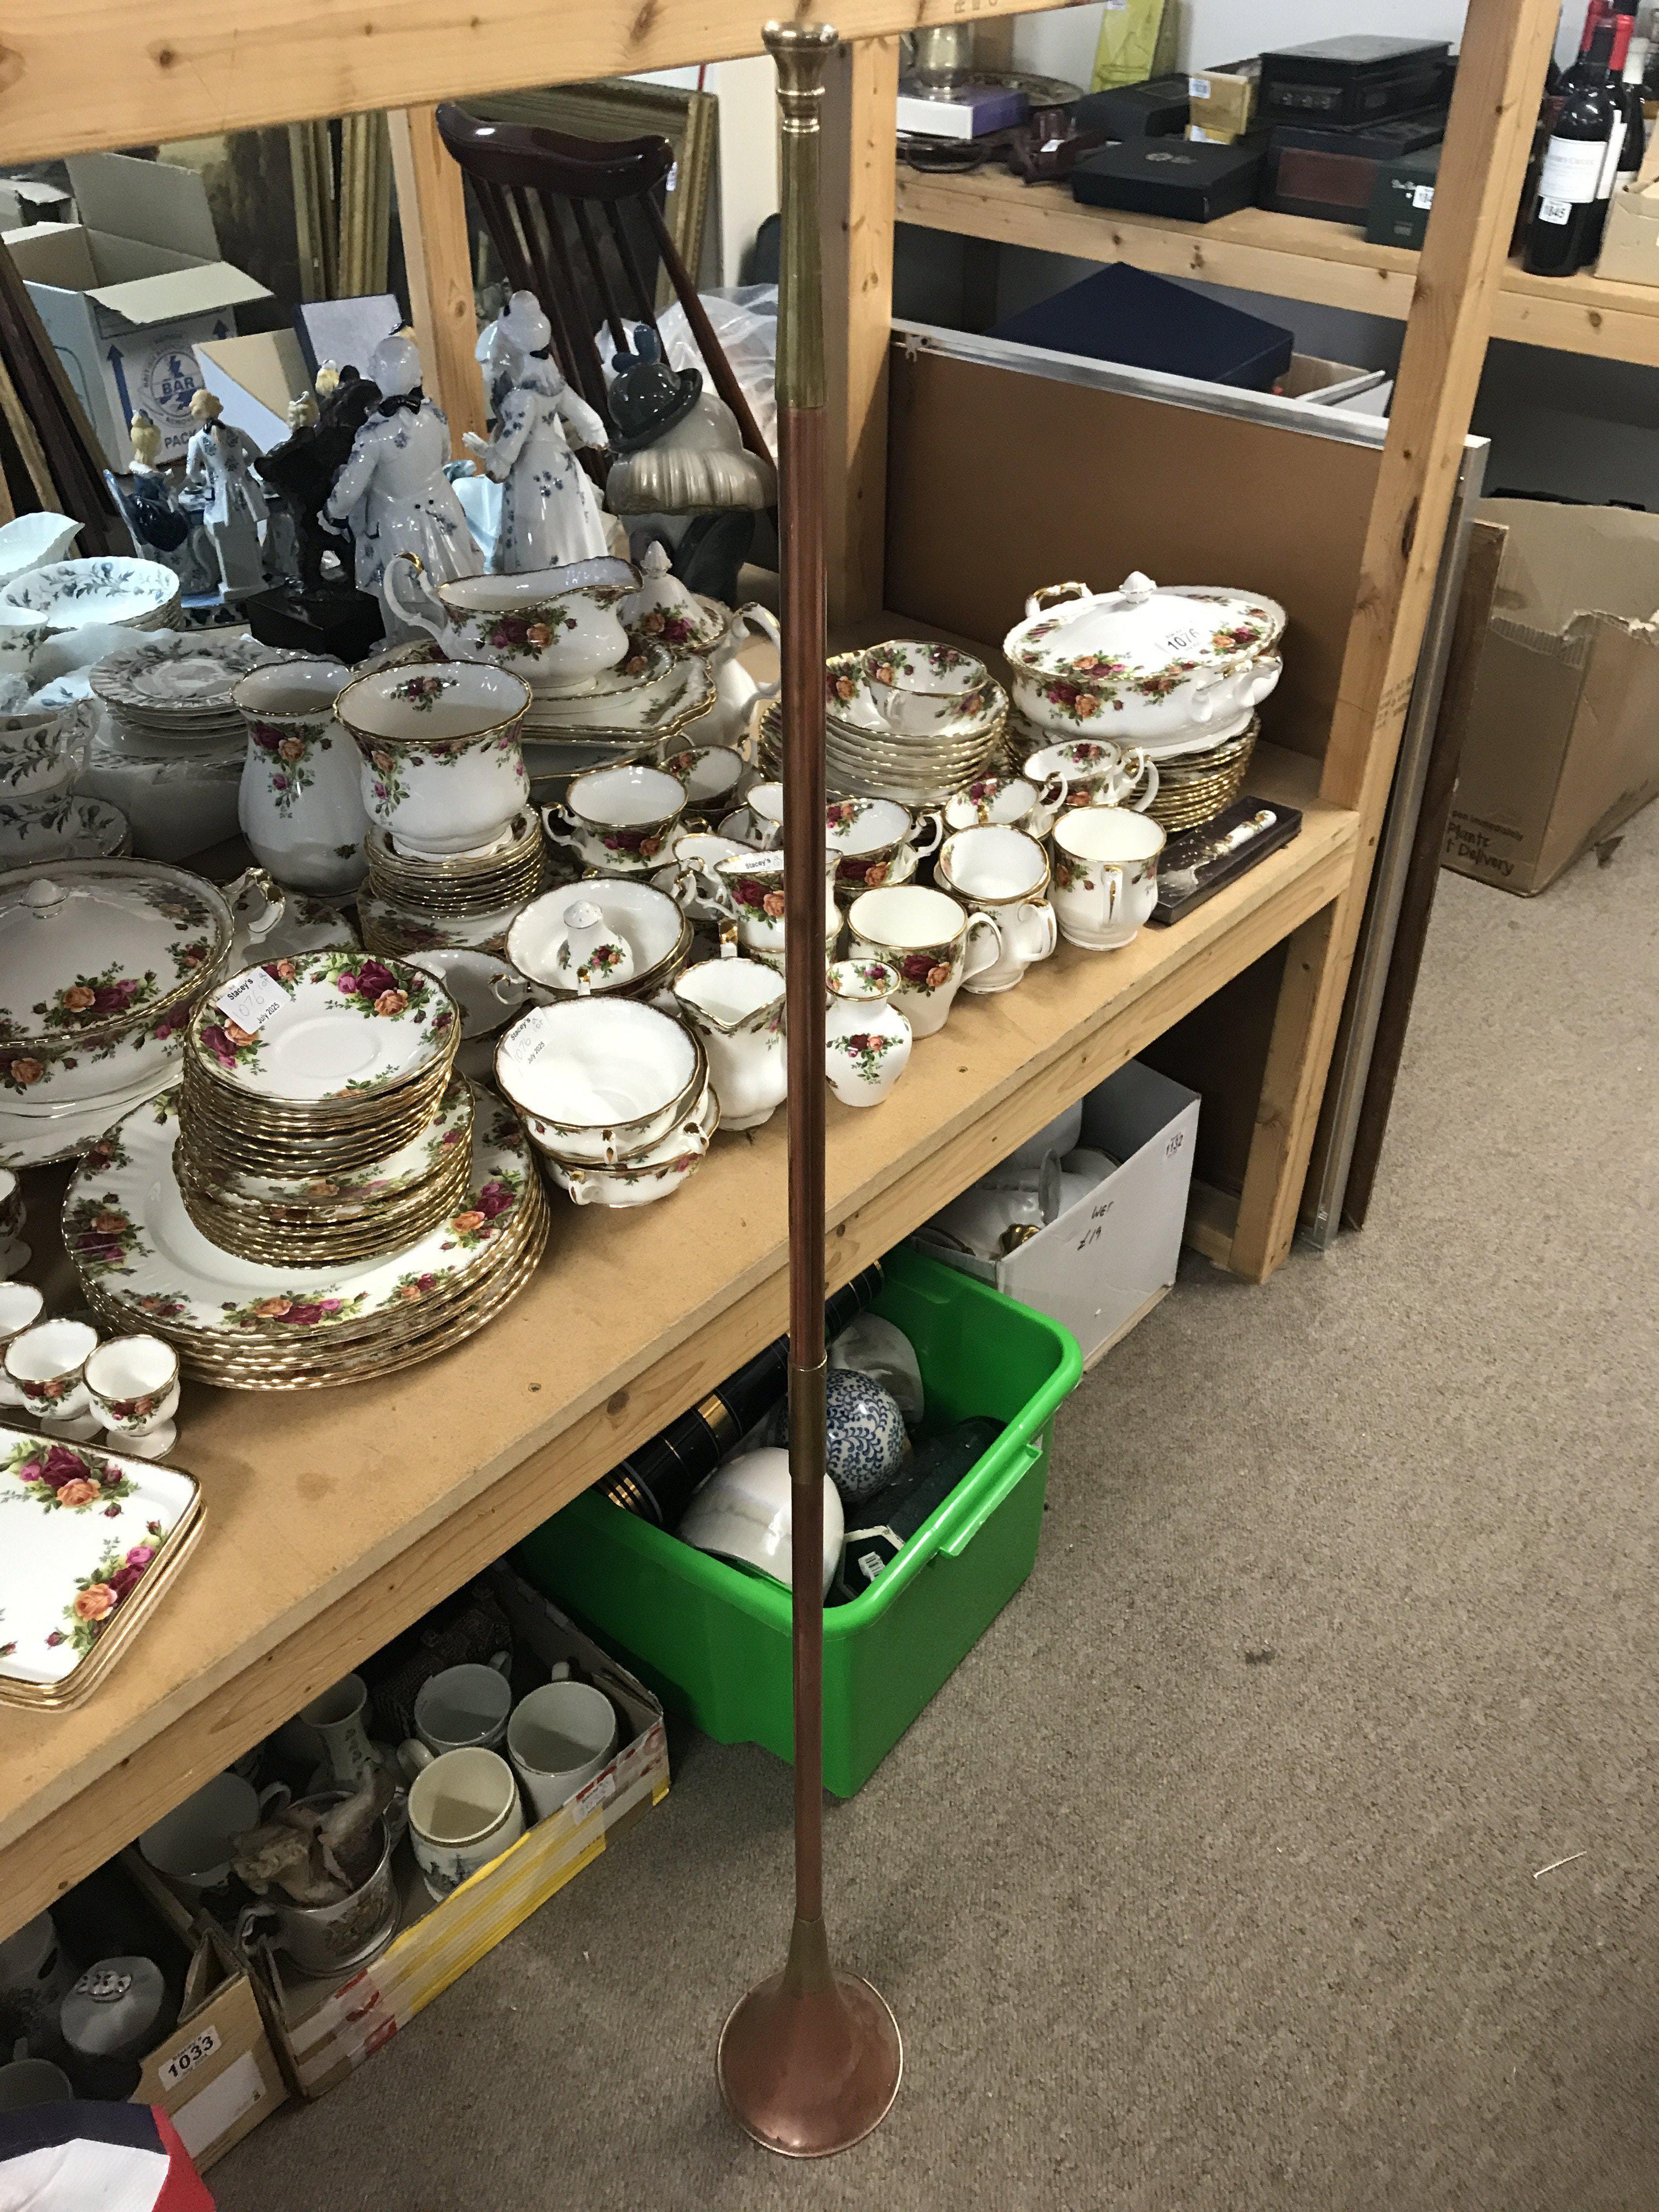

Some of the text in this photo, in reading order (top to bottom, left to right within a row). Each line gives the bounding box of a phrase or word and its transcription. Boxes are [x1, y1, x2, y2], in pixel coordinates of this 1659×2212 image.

[162, 377, 196, 395] BAR
[745, 858, 771, 870] Stacey's
[1458, 843, 1515, 876] Delivery
[227, 978, 253, 1000] Stacey's
[232, 990, 264, 1020] 1076
[257, 1002, 280, 1024] July 2025
[510, 1018, 531, 1041] Stacey's
[528, 1041, 545, 1064] July 2025
[168, 2036, 213, 2078] 1033
